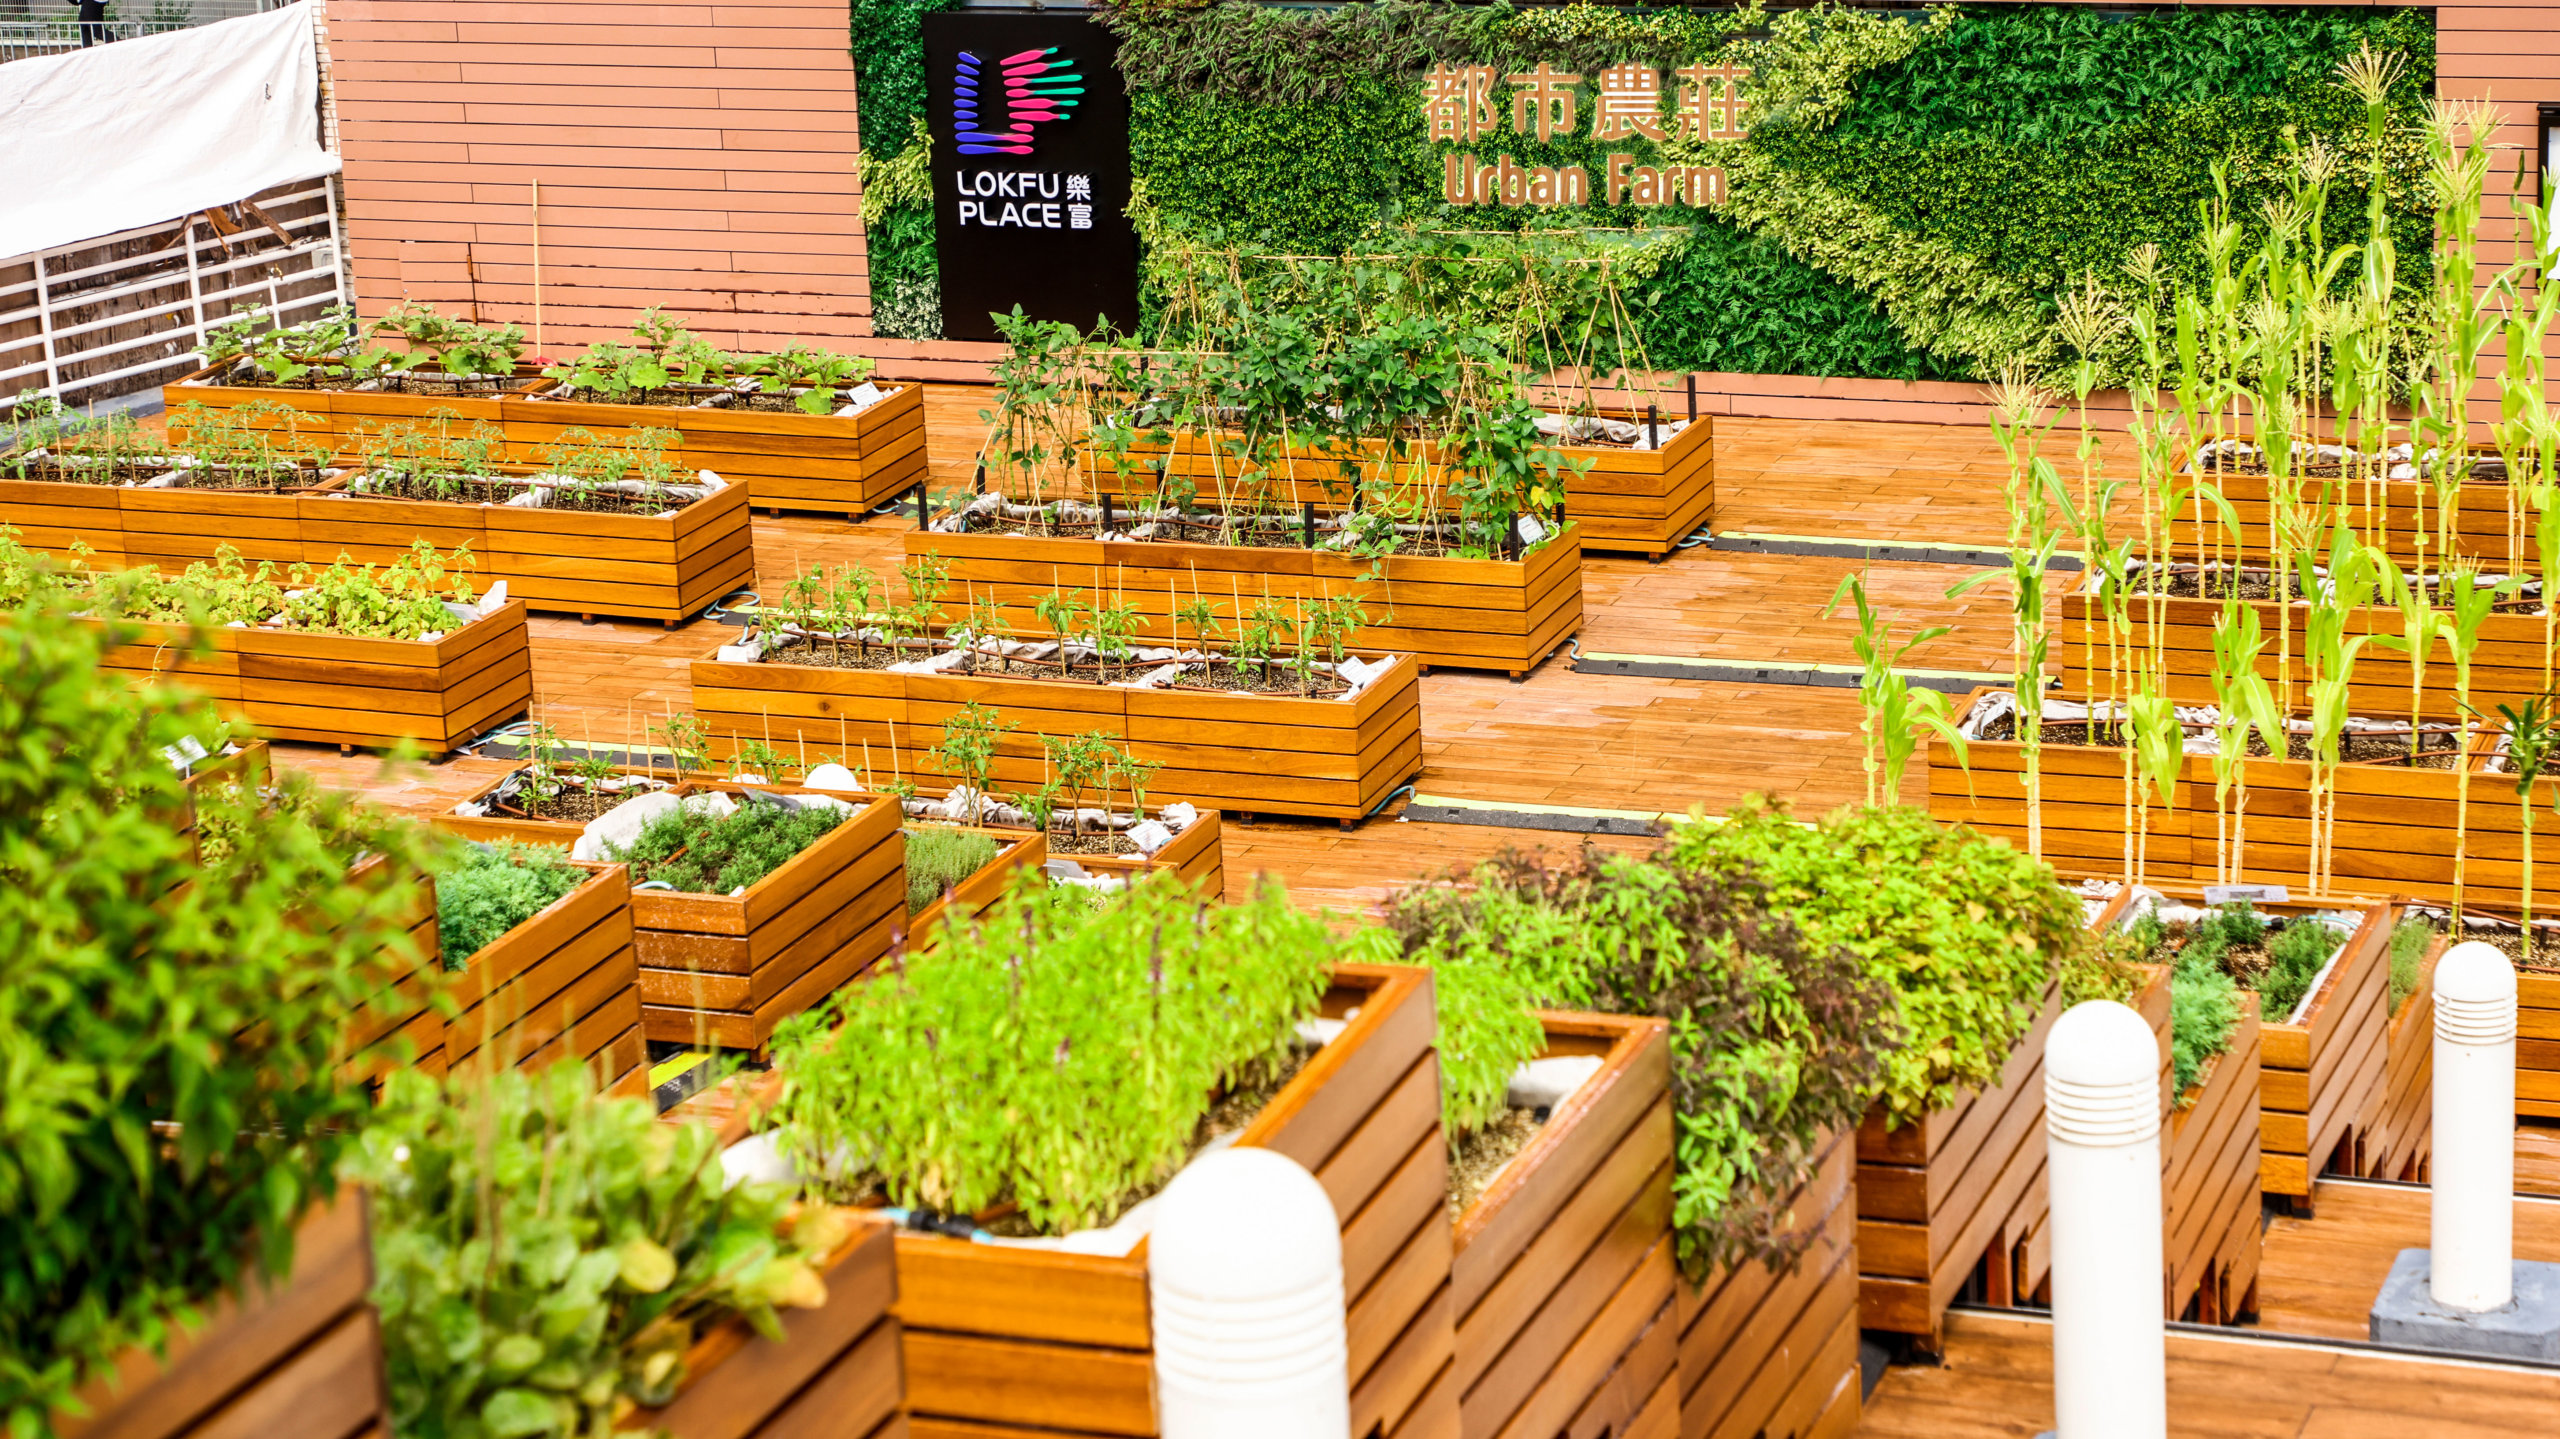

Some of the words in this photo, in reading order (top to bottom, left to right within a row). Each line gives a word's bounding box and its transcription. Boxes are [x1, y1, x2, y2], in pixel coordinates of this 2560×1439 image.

[1421, 62, 1751, 143] 都市農莊
[956, 171, 1060, 199] LOKFU
[1445, 154, 1588, 206] Urban
[1608, 154, 1726, 206] Farm
[958, 201, 1062, 229] PLACE
